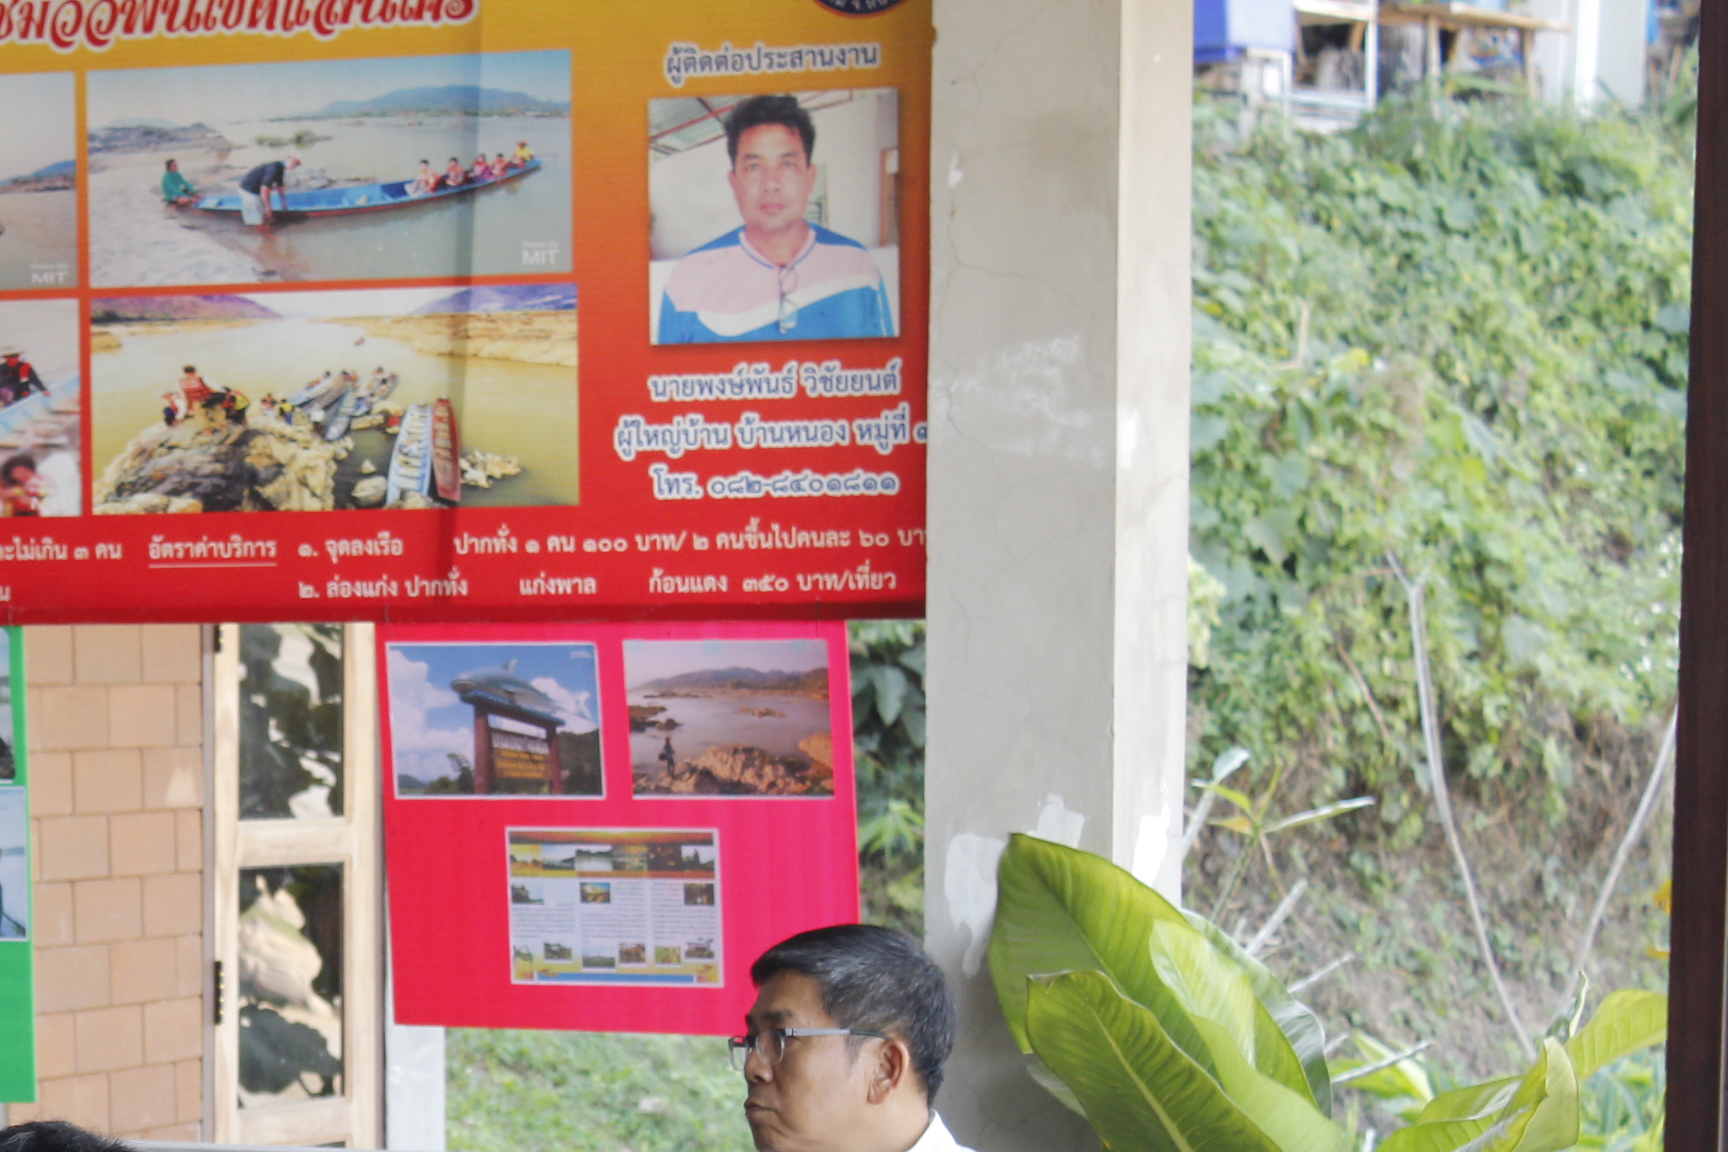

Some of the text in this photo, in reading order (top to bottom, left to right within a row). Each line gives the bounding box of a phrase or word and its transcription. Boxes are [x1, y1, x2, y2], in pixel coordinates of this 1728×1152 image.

[666, 45, 879, 84] ผู้ติดต่อประสานงาน
[521, 250, 560, 265] MIT
[31, 271, 68, 284] MIT
[651, 360, 900, 397] นายพงษ์พันธ์ วิชัยยนต์
[617, 416, 729, 458] ผู้ใหญ่บ้าน
[738, 413, 848, 445] บ้านหนอง
[856, 404, 907, 452] หมู่ที่
[652, 467, 897, 496] โทร. ๐๘๒-๘๔๐๑๘๑๑
[95, 542, 123, 560] คน
[148, 533, 277, 559] อัตราค่าบริการ
[325, 530, 404, 563] จุดลงเรือ
[547, 534, 576, 553] คน
[583, 537, 628, 552] ๑๐๐
[716, 517, 851, 550] คนขึ้นไปคนละ
[859, 528, 890, 547] ๖๐
[897, 527, 926, 546] บา
[326, 574, 398, 598] ล่องแก่ง
[519, 571, 597, 596] แก่งพาล
[649, 566, 728, 594] ก้อนแดง
[796, 559, 897, 592] บาท/เที่ยว
